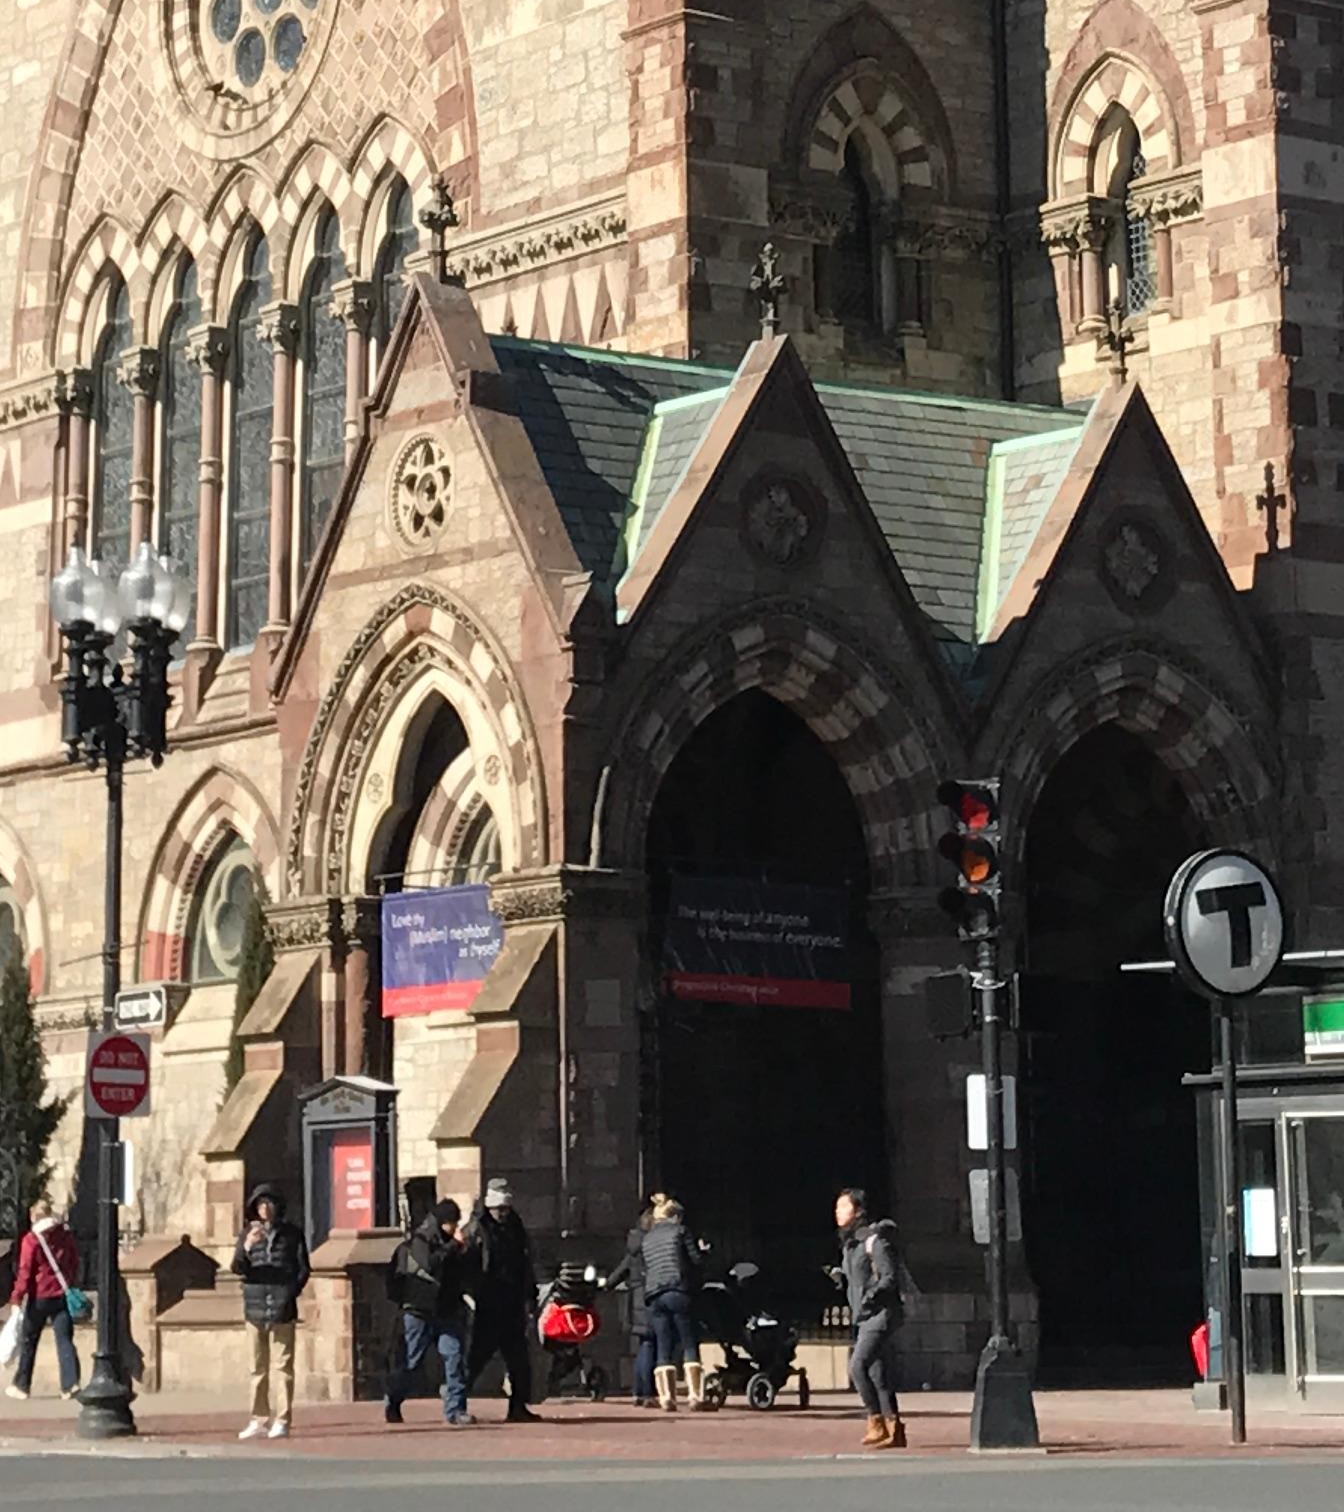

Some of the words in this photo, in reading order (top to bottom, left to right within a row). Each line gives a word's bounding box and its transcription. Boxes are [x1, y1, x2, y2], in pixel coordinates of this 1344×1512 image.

[765, 913, 810, 929] anyone
[1195, 881, 1267, 968] T
[99, 1050, 115, 1065] DO
[118, 1052, 139, 1065] NOT
[101, 1086, 136, 1101] ENTER
